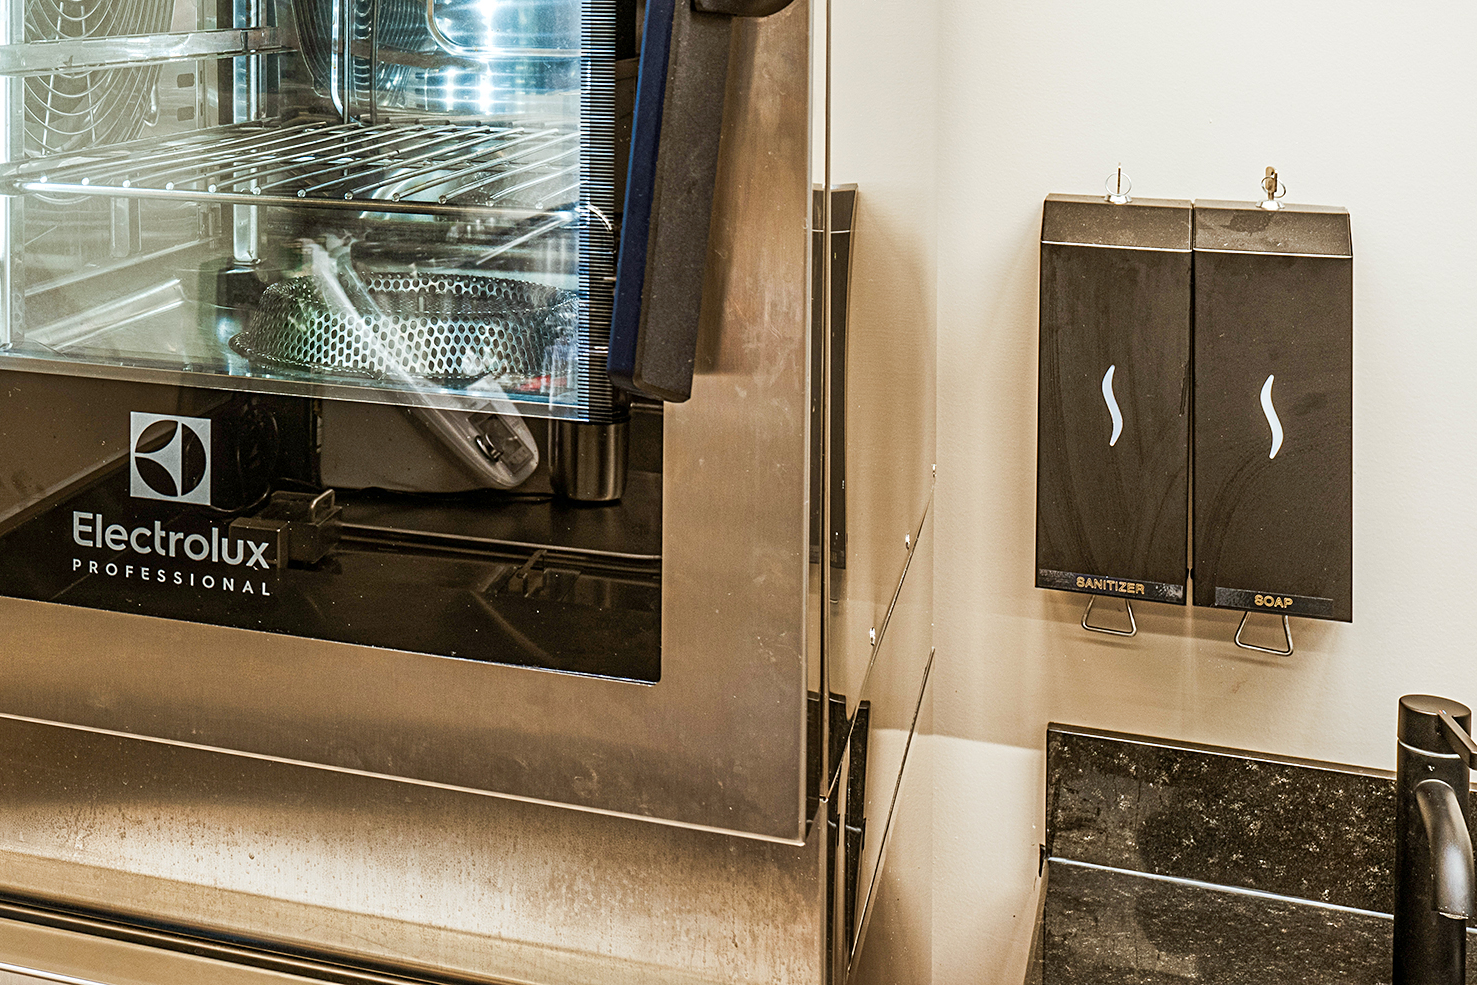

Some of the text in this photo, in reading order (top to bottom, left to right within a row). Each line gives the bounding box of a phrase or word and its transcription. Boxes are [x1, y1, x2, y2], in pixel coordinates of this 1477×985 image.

[72, 510, 270, 570] Electrolux
[72, 558, 271, 597] PROFESSIONAL
[1075, 575, 1146, 596] SANITIZER
[1253, 594, 1294, 609] SOAP
